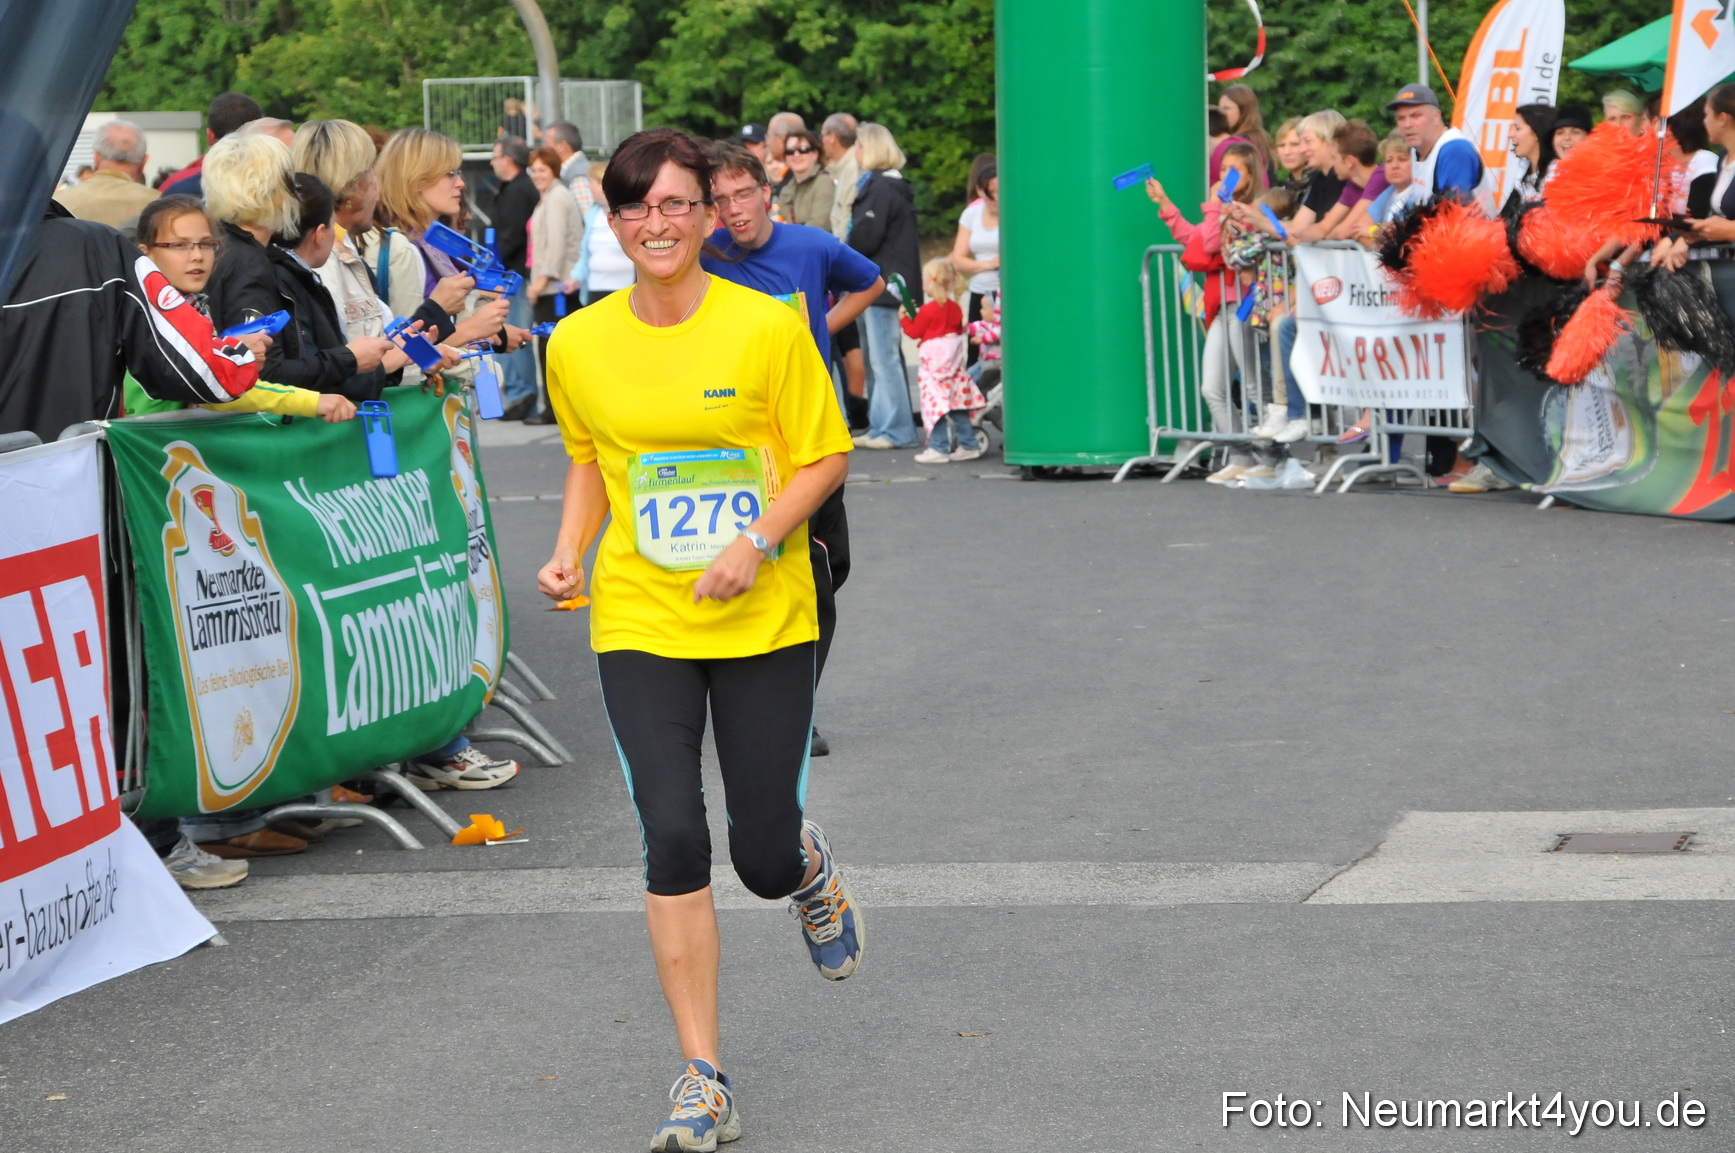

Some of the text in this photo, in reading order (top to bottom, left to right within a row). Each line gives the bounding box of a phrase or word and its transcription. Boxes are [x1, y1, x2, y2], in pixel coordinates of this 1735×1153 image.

[1319, 330, 1446, 380] XL-PRINT
[703, 388, 736, 398] KANN
[283, 468, 439, 568] Neumarkter
[639, 491, 760, 540] 1279
[670, 541, 706, 553] Katrin
[196, 560, 266, 601] Neumarkter
[186, 594, 281, 651] Lammsbräu
[302, 552, 475, 736] Lammsbräu
[197, 658, 290, 696] Das feine ökologische Bier
